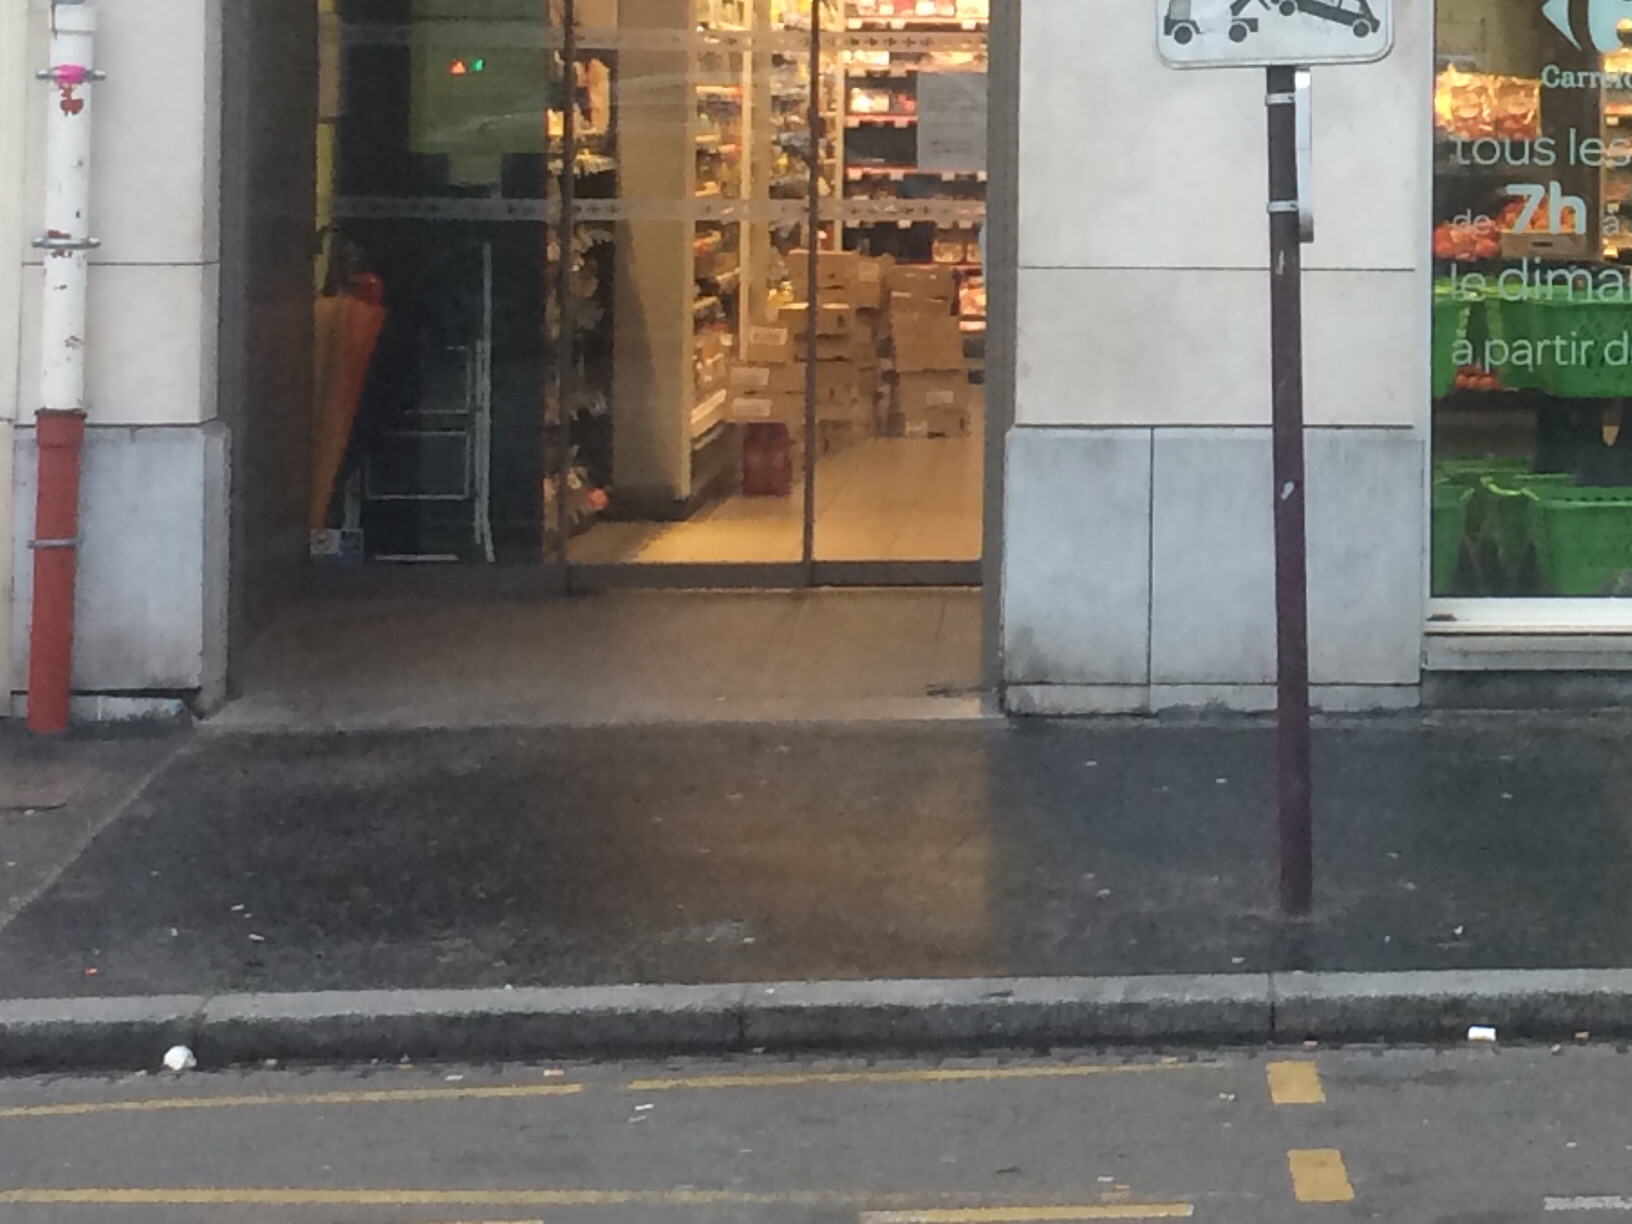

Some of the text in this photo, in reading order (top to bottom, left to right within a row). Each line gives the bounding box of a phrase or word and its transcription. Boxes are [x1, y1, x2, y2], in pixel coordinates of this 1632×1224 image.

[1452, 133, 1556, 166] tous
[1569, 128, 1631, 167] les
[1452, 208, 1491, 234] de
[1506, 181, 1587, 235] 7h
[1450, 262, 1486, 301] le
[1484, 330, 1594, 373] partir
